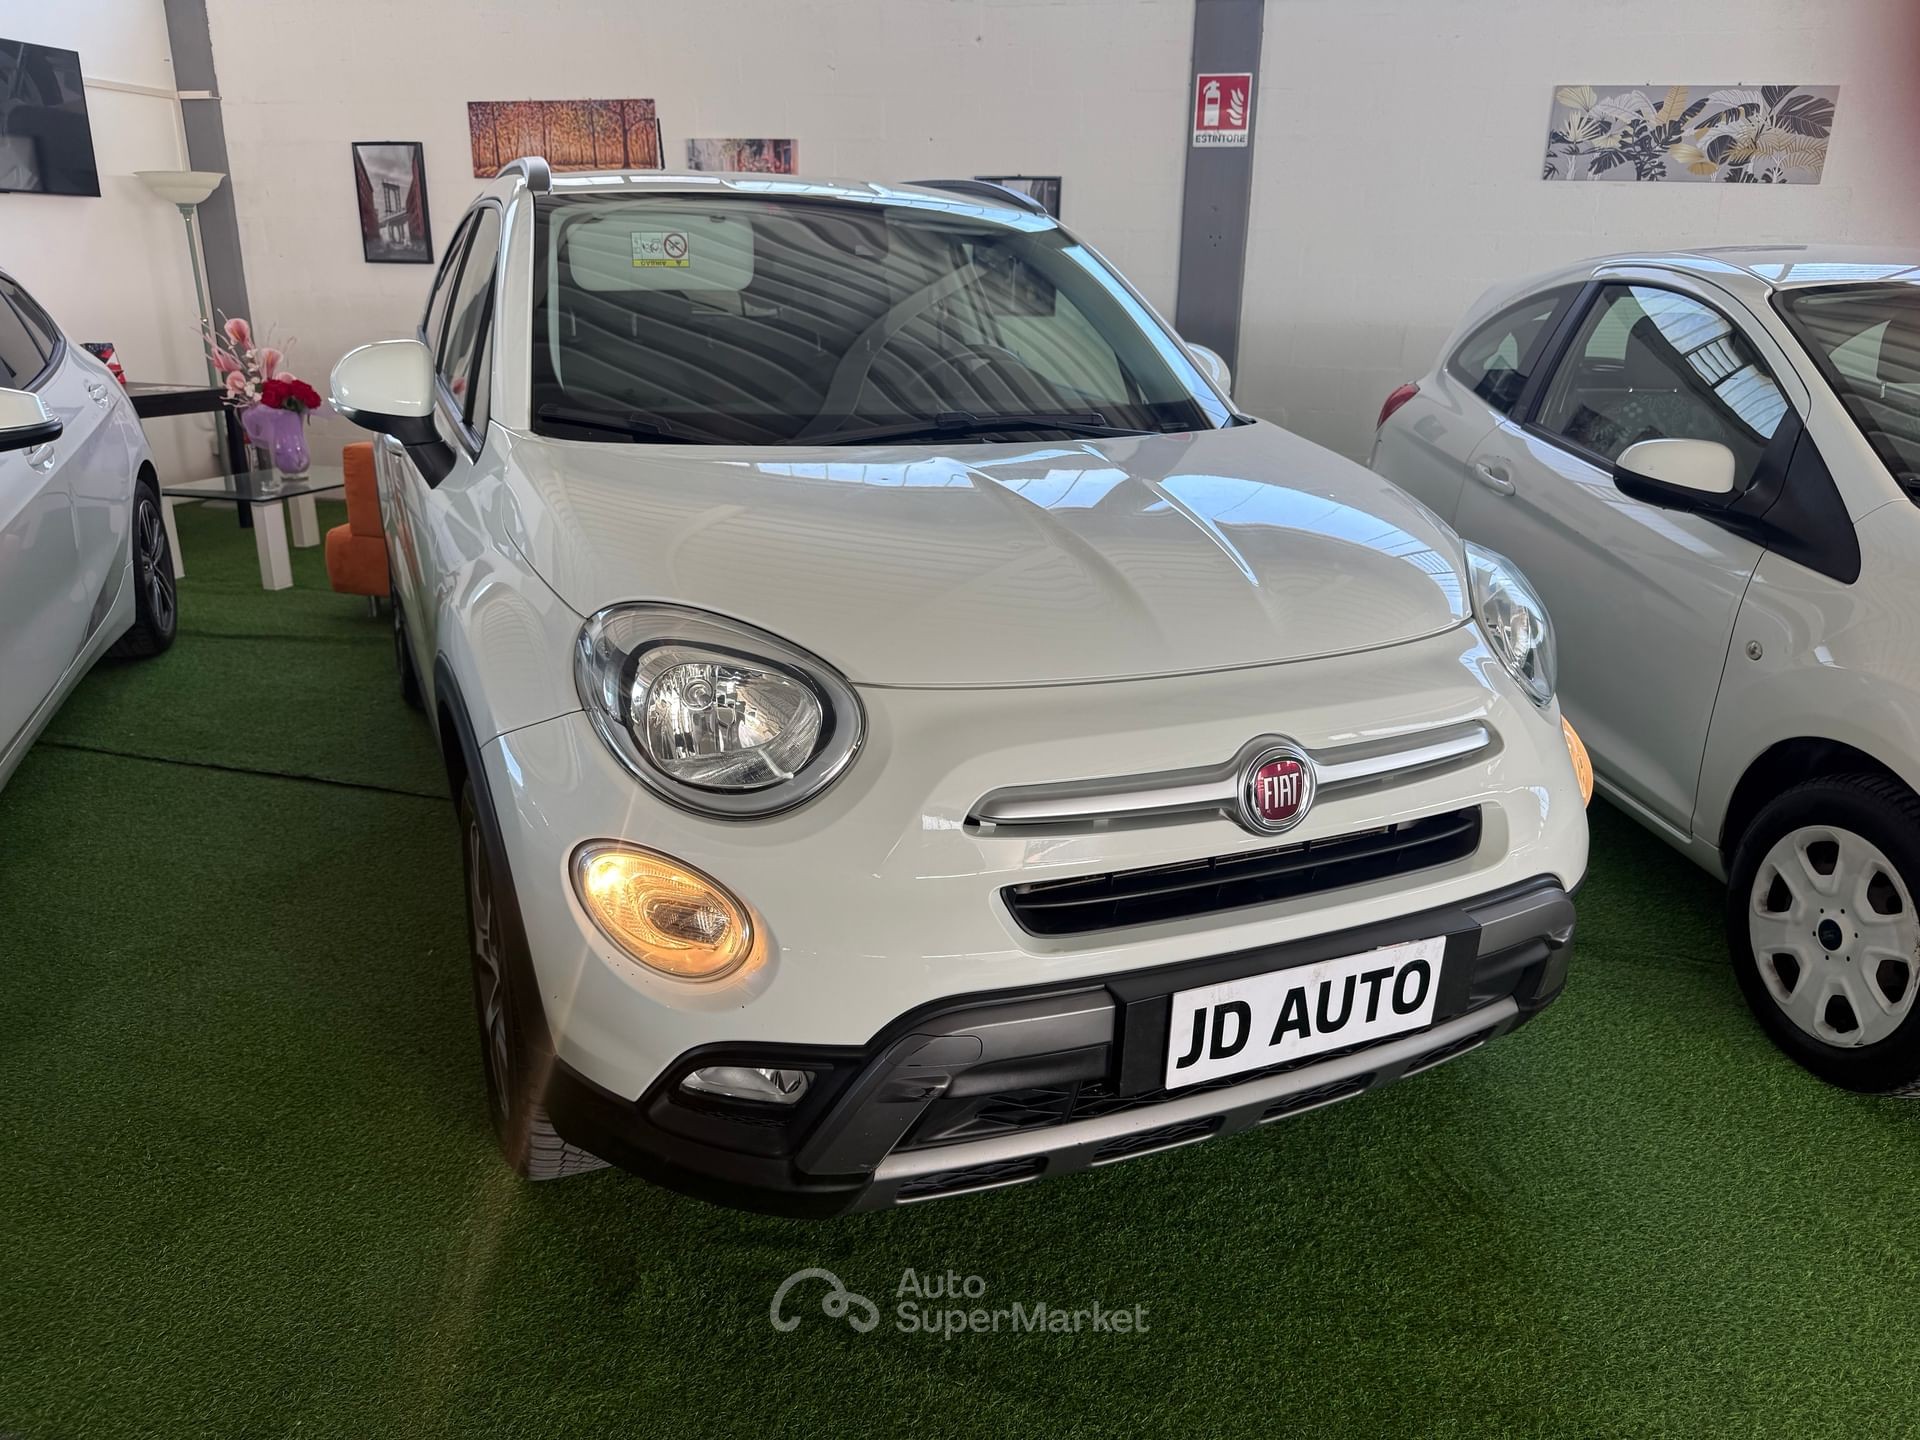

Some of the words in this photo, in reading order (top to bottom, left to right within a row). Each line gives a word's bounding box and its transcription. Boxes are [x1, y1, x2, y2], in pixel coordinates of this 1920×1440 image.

[1195, 134, 1246, 143] ESTINTORE
[1263, 772, 1299, 810] FIAT
[1175, 1000, 1251, 1069] JD
[1268, 959, 1431, 1047] AUTO
